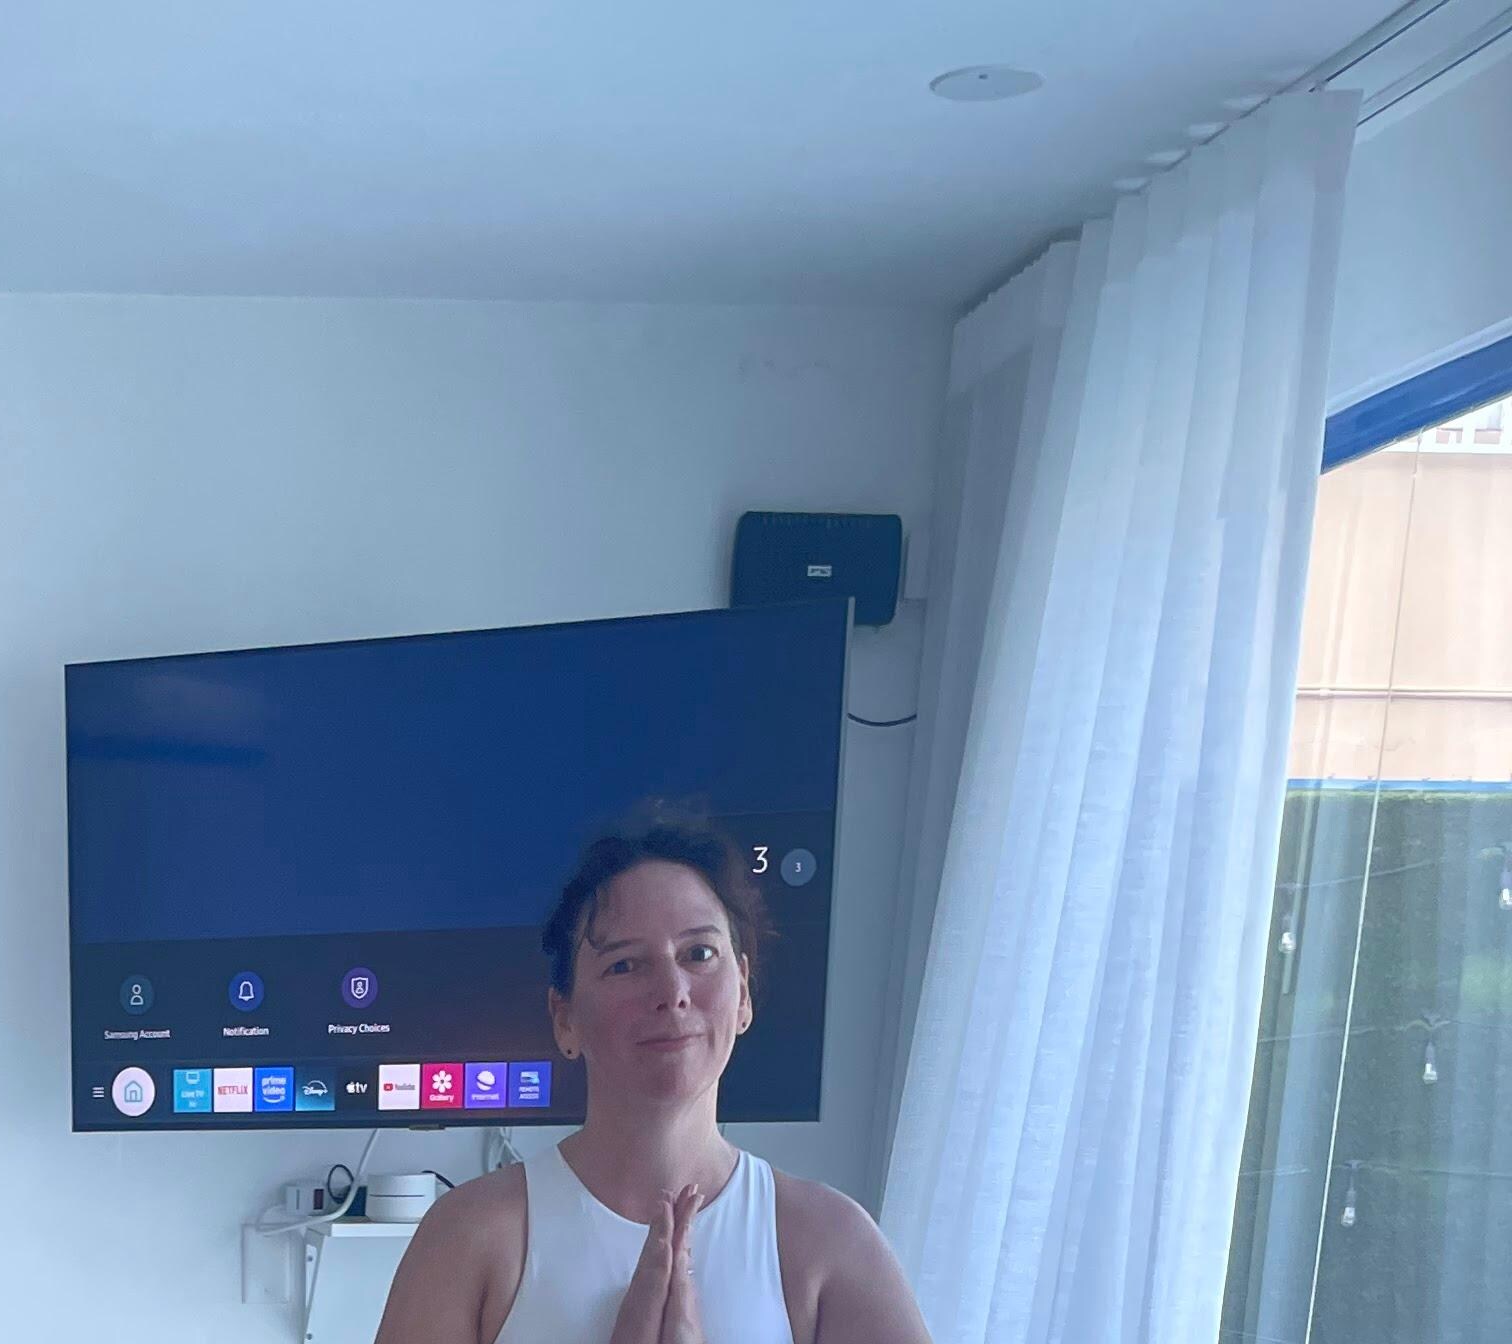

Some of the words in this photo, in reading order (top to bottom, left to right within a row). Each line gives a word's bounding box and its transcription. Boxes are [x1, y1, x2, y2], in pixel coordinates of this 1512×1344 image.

[752, 846, 768, 873] 3
[223, 1026, 269, 1036] Notification
[328, 1023, 358, 1035] Privacy
[359, 1023, 390, 1033] Choices
[104, 1030, 138, 1041] Samsung
[139, 1029, 171, 1039] Account
[217, 1085, 248, 1095] NETFLIX
[262, 1085, 286, 1096] video
[429, 1094, 453, 1103] Gallery
